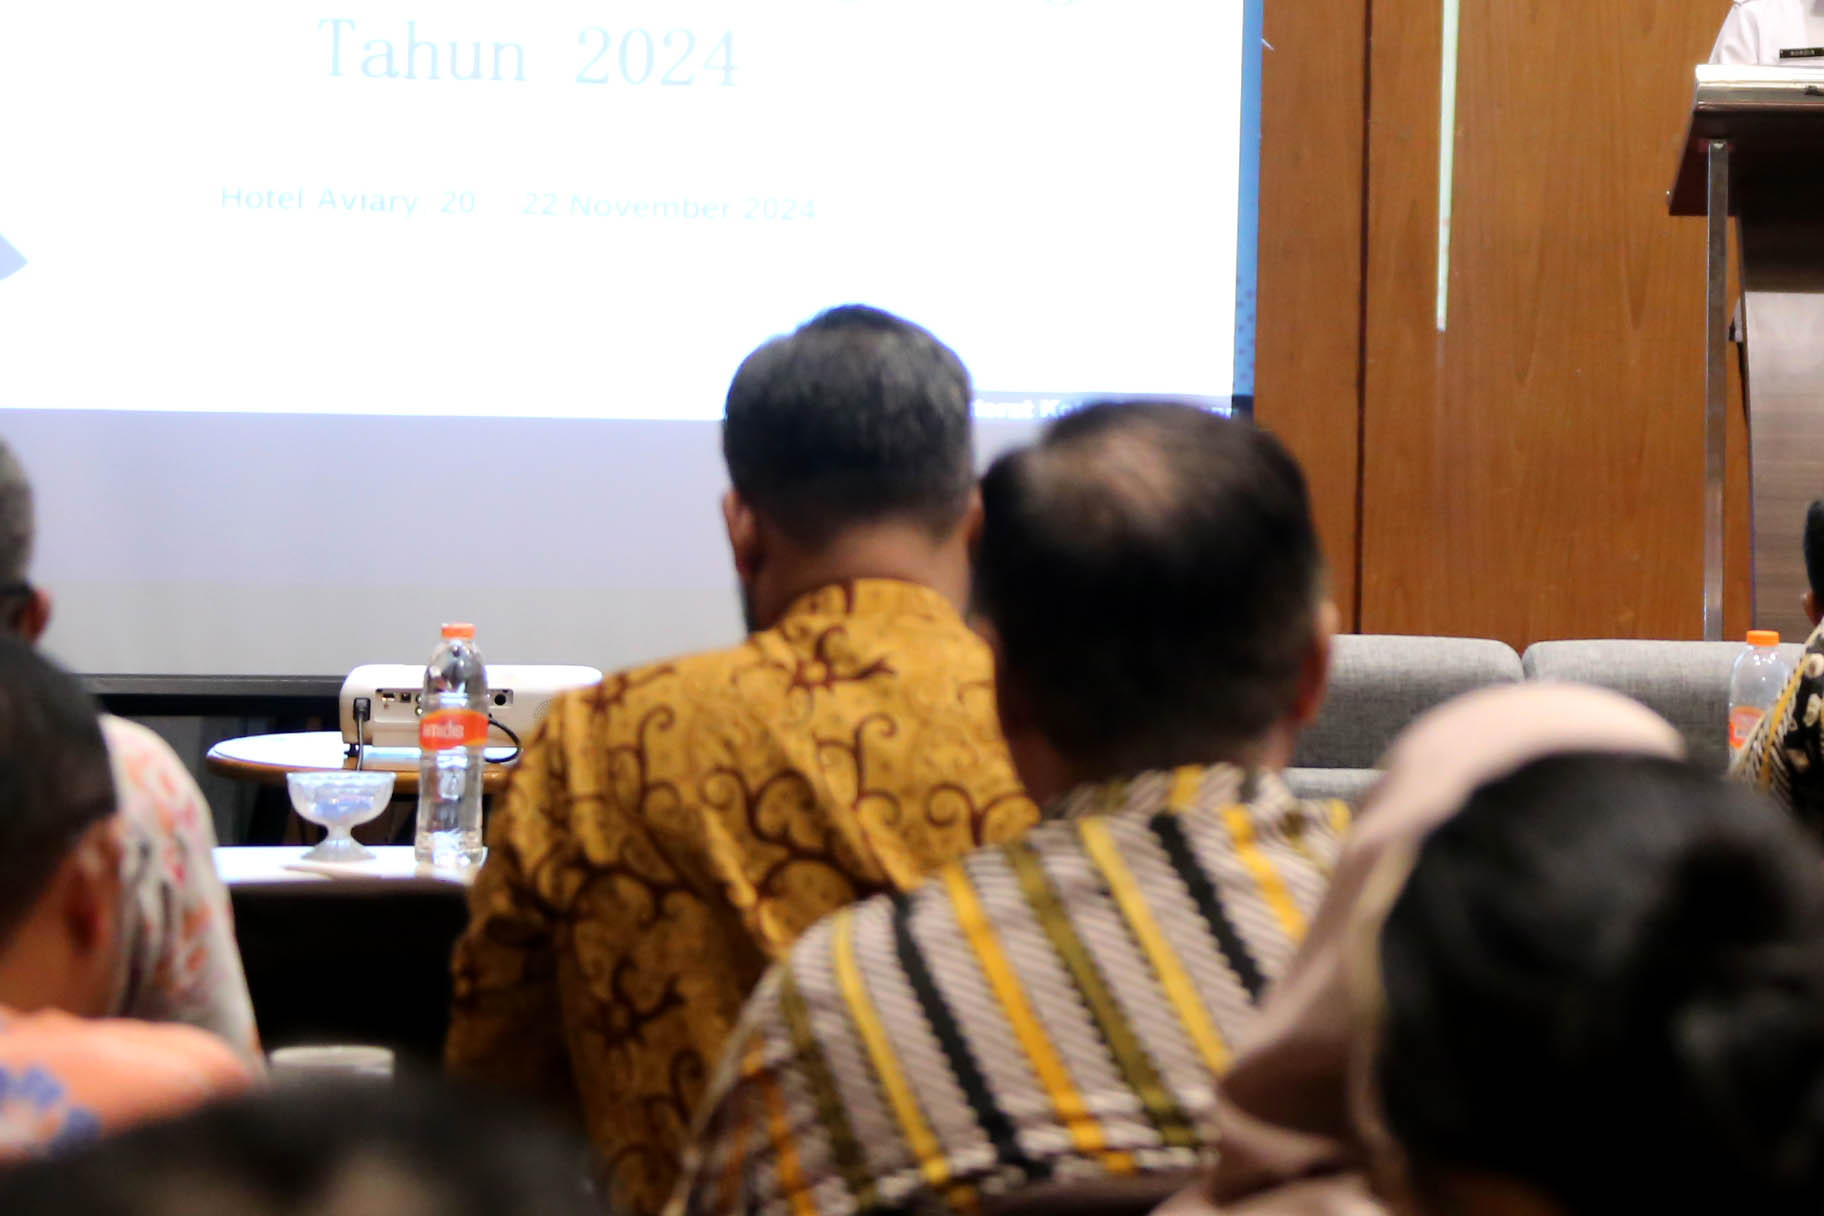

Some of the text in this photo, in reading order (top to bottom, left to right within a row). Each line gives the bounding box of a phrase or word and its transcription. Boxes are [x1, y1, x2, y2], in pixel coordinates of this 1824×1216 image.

[317, 17, 738, 88] Tahun 2024
[220, 184, 304, 210] Hotel
[440, 191, 477, 214] 20
[521, 192, 558, 216] 22
[570, 193, 728, 220] November
[744, 197, 816, 221] 2024
